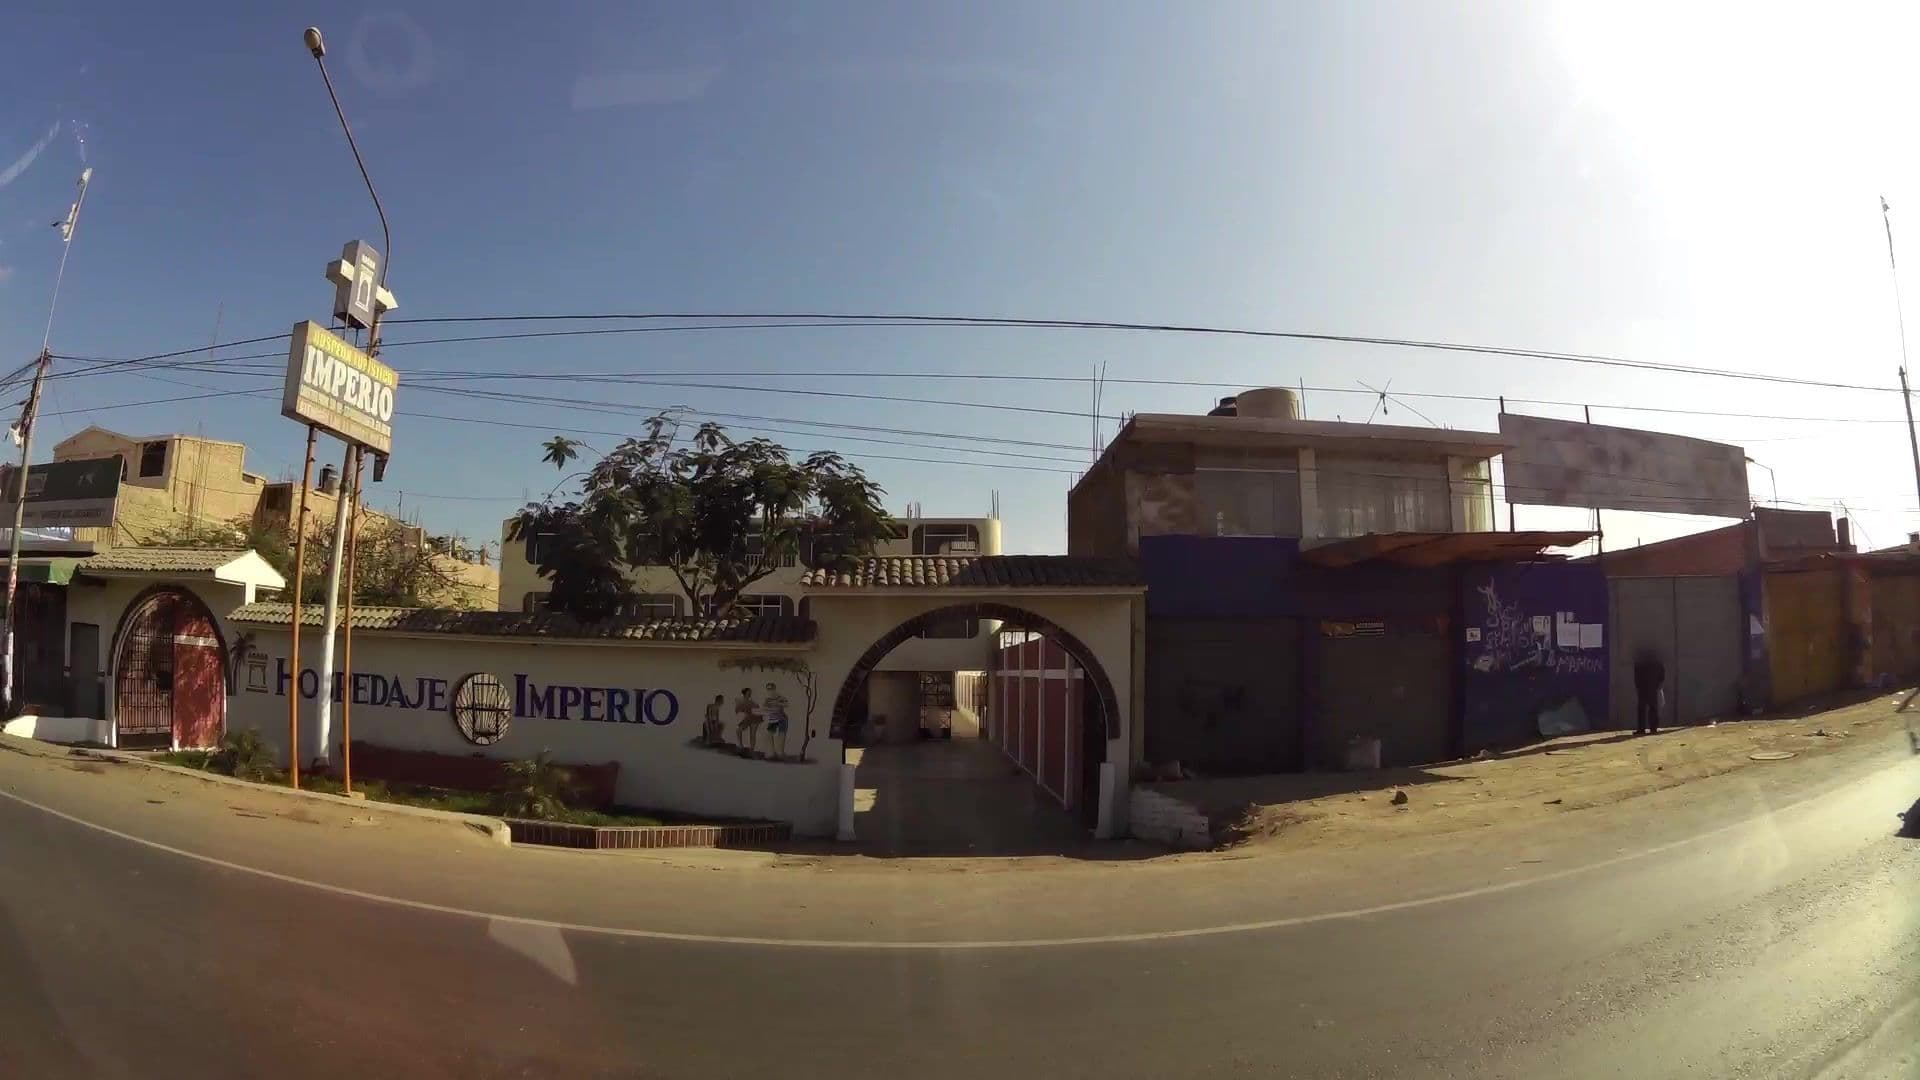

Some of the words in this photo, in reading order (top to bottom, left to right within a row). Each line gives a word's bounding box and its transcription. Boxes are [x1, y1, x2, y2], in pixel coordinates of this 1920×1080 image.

[303, 344, 394, 422] IMPERIO
[275, 656, 449, 712] HOPEDAJE
[514, 673, 680, 726] IMPERIO
